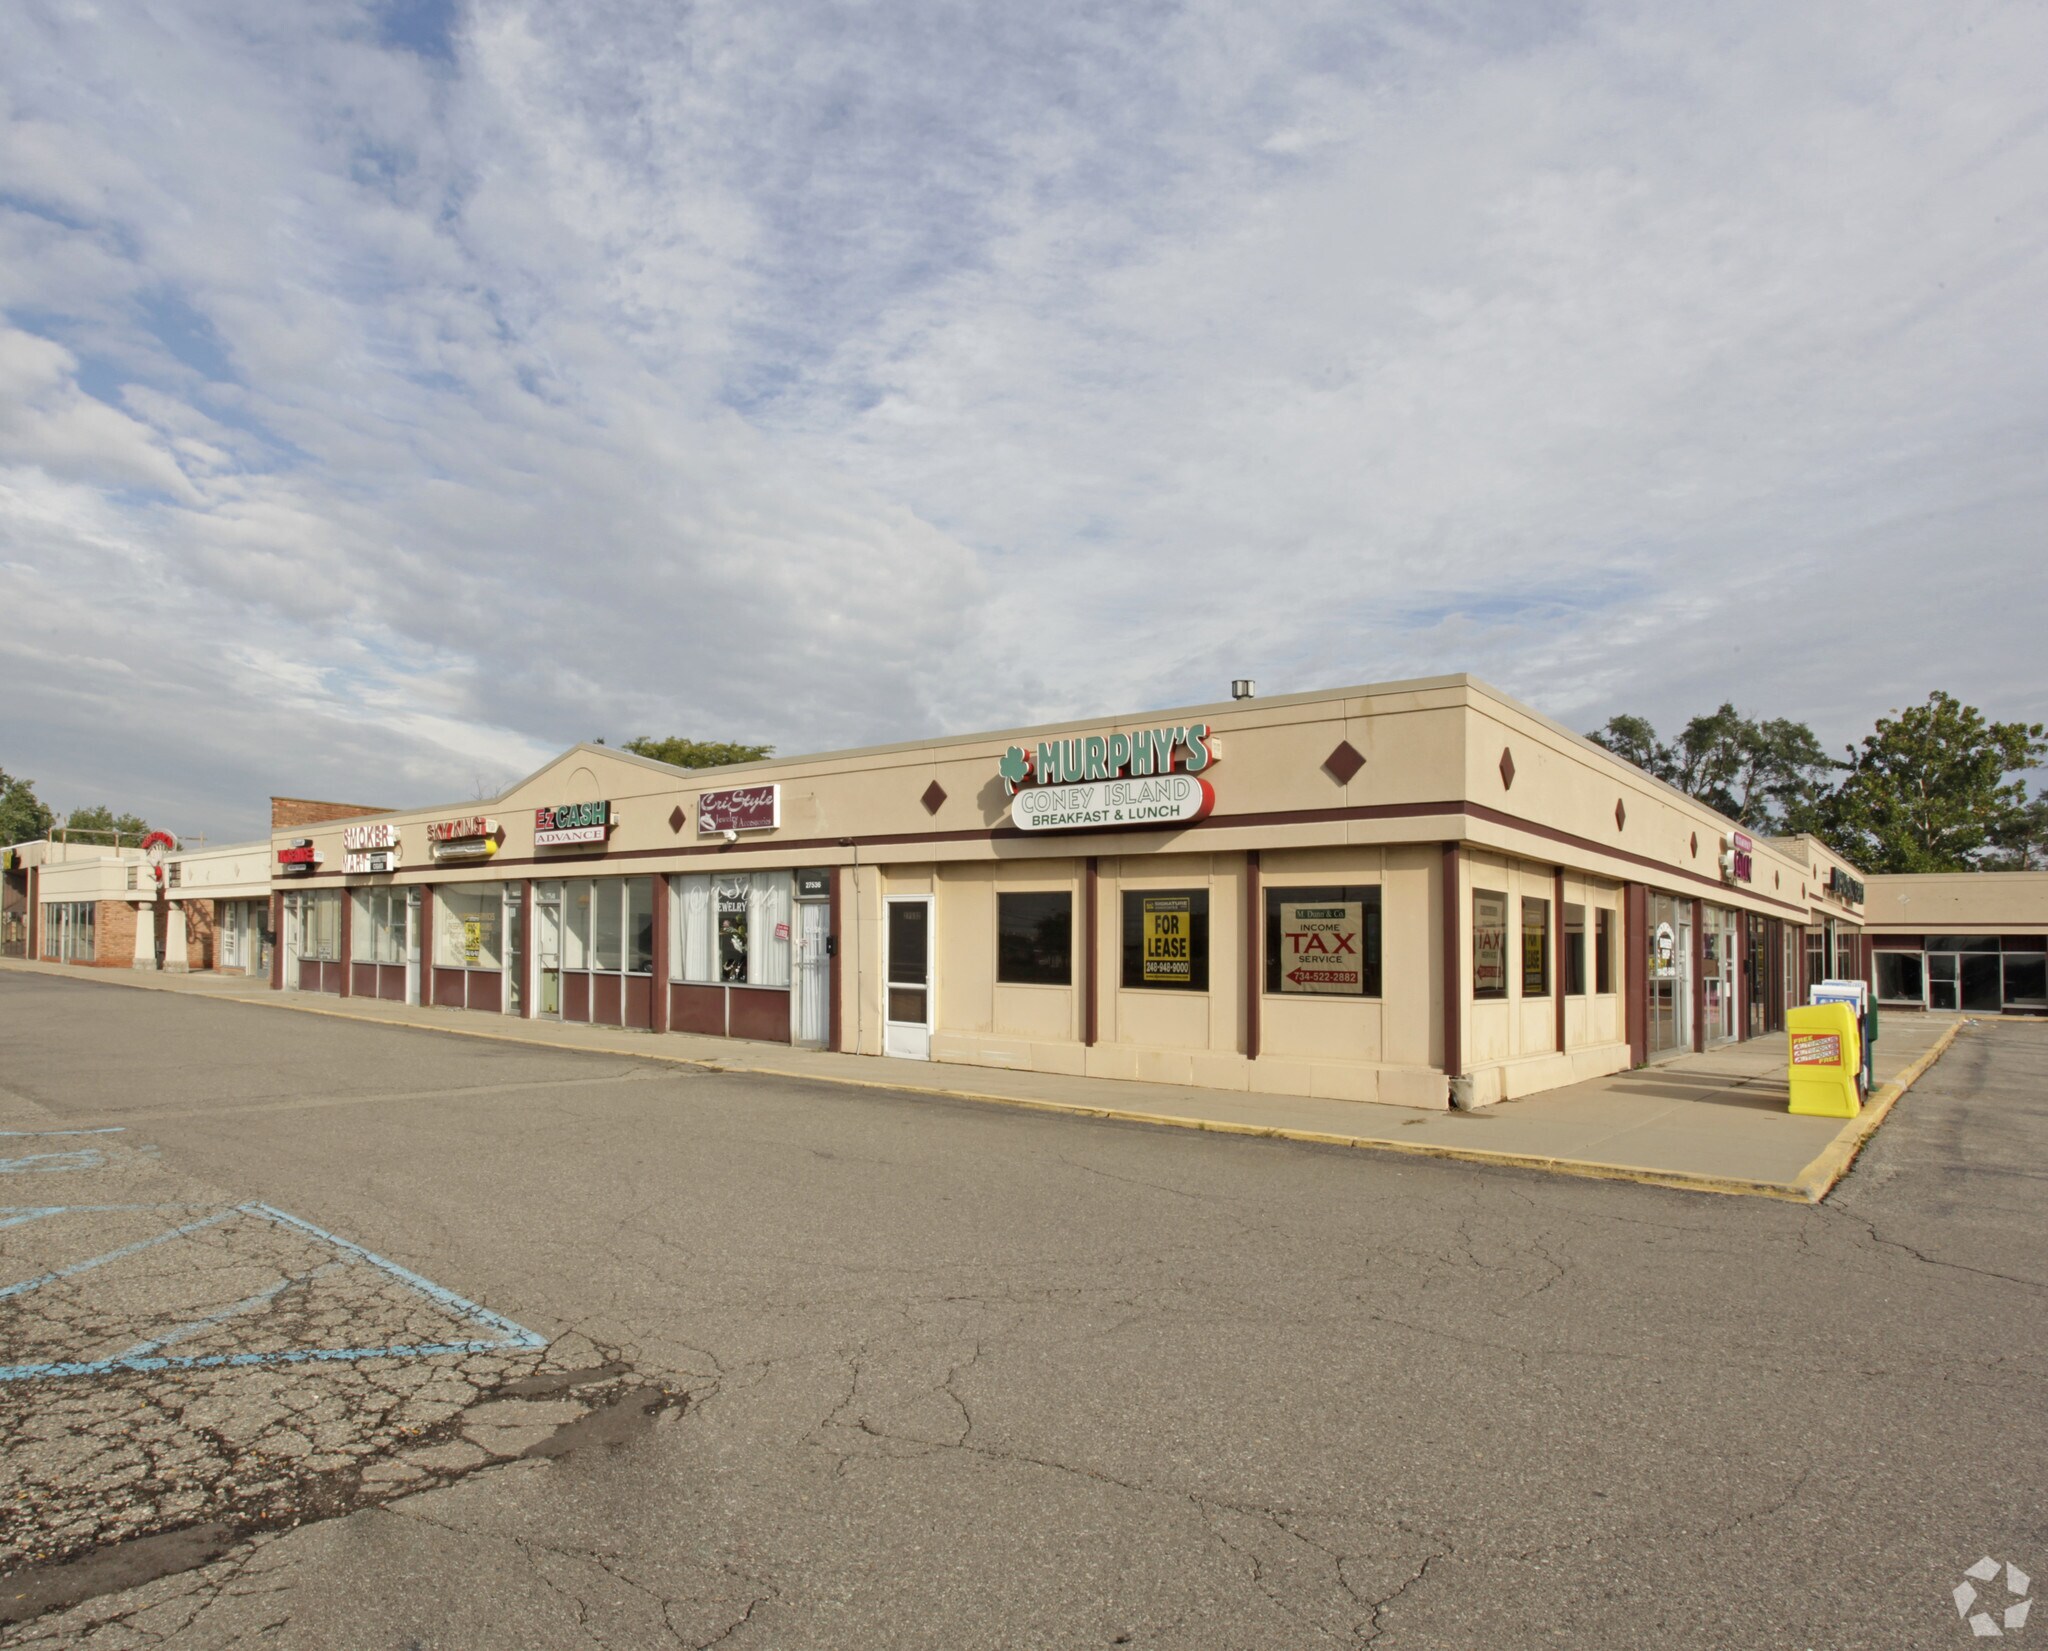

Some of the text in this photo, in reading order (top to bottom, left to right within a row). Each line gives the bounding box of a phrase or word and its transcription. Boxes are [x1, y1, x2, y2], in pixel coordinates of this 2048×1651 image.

[1037, 724, 1207, 784] MURPHY'S
[1021, 778, 1190, 814] CONEY ISLAND
[556, 800, 605, 828] CASH
[1032, 805, 1180, 826] BREAKFAST & LUNCH
[343, 824, 389, 850] SMOKER
[427, 816, 482, 841] SKY KING
[537, 830, 602, 843] ADVANCE
[343, 852, 369, 873] MART
[1155, 915, 1179, 934] FOR
[1147, 938, 1187, 958] LEASE
[1285, 932, 1357, 954] TAX
[1298, 956, 1343, 964] SERVICE
[1294, 972, 1356, 982] 734-522-2882
[1794, 1035, 1813, 1045] FREE
[1818, 1055, 1840, 1064] FREE
